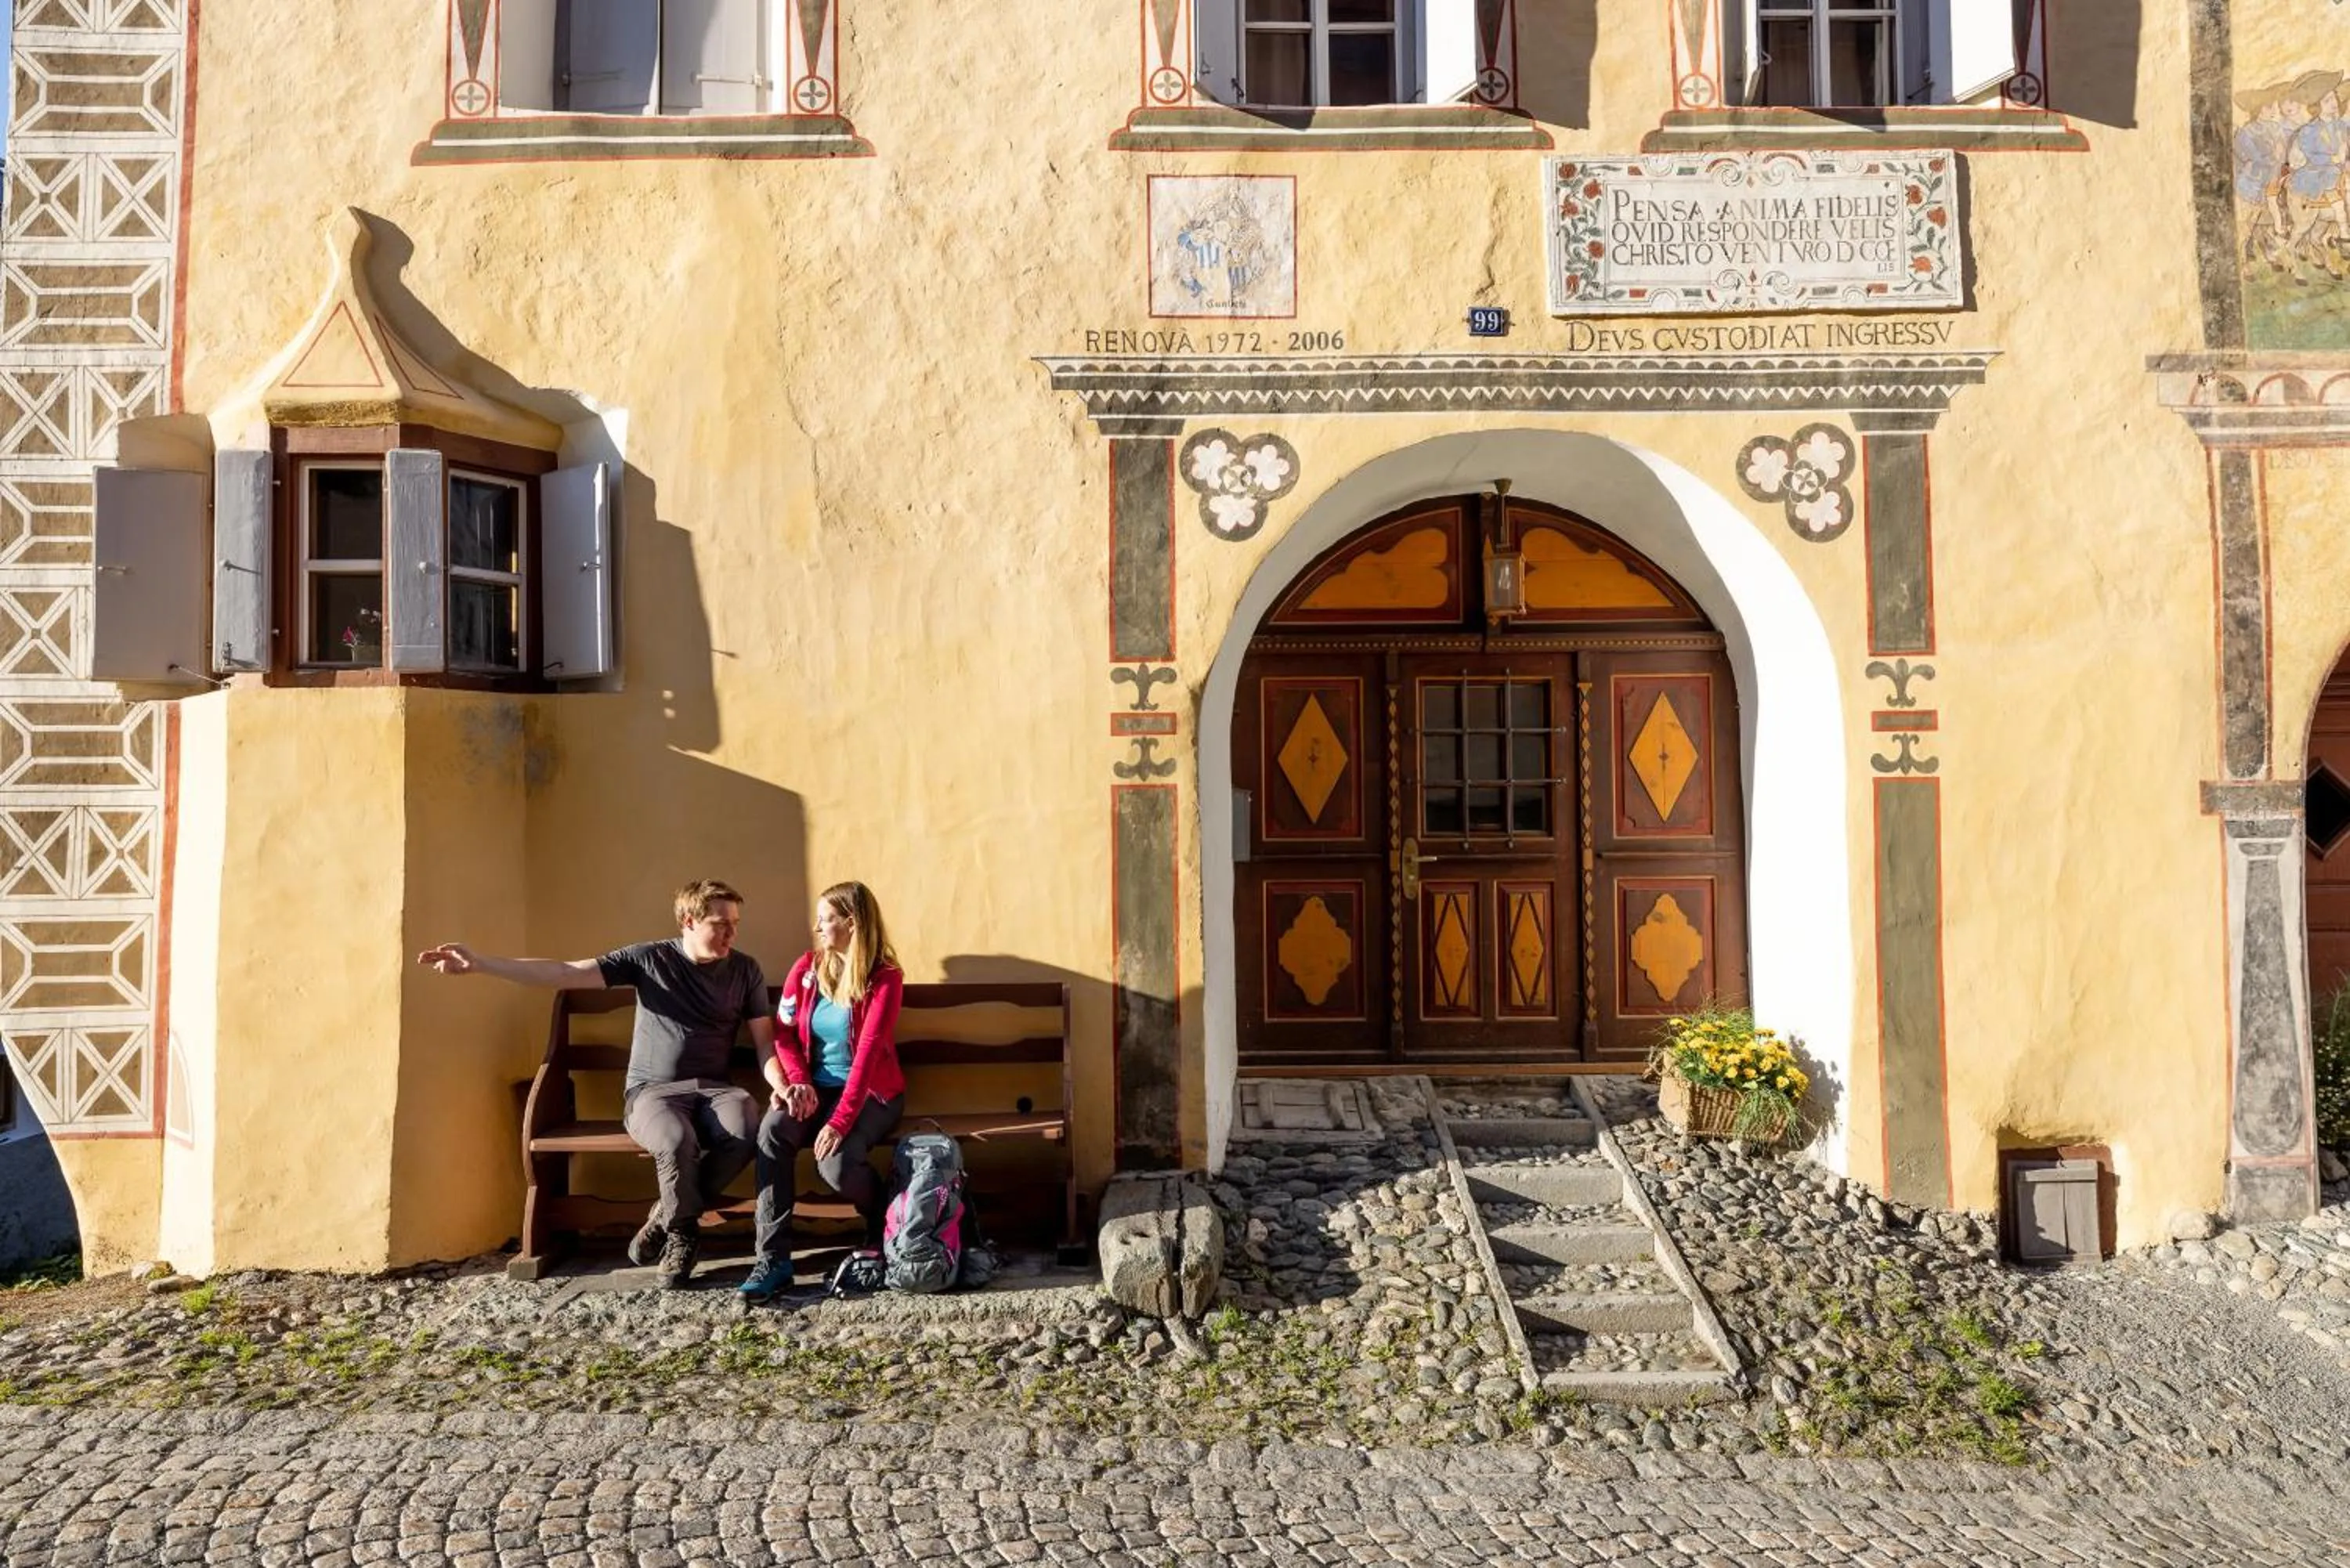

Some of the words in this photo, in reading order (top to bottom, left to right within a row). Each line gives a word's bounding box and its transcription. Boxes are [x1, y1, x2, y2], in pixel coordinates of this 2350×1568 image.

[1612, 190, 1705, 222] PENSA
[1719, 198, 1808, 220] ANIMA
[1816, 195, 1899, 219] FIDELIS
[1611, 222, 1675, 244] QVID
[1682, 220, 1824, 242] RESPONDERE
[1831, 218, 1896, 240] VELIS
[1611, 244, 1713, 266] CHRISTO
[1475, 311, 1499, 331] 99
[1206, 332, 1263, 352] 1972
[1289, 331, 1344, 352] 2006
[1567, 321, 1645, 352] DEVS
[1654, 323, 1817, 351] CVSTODIAT
[1826, 321, 1955, 347] INGRESSV
